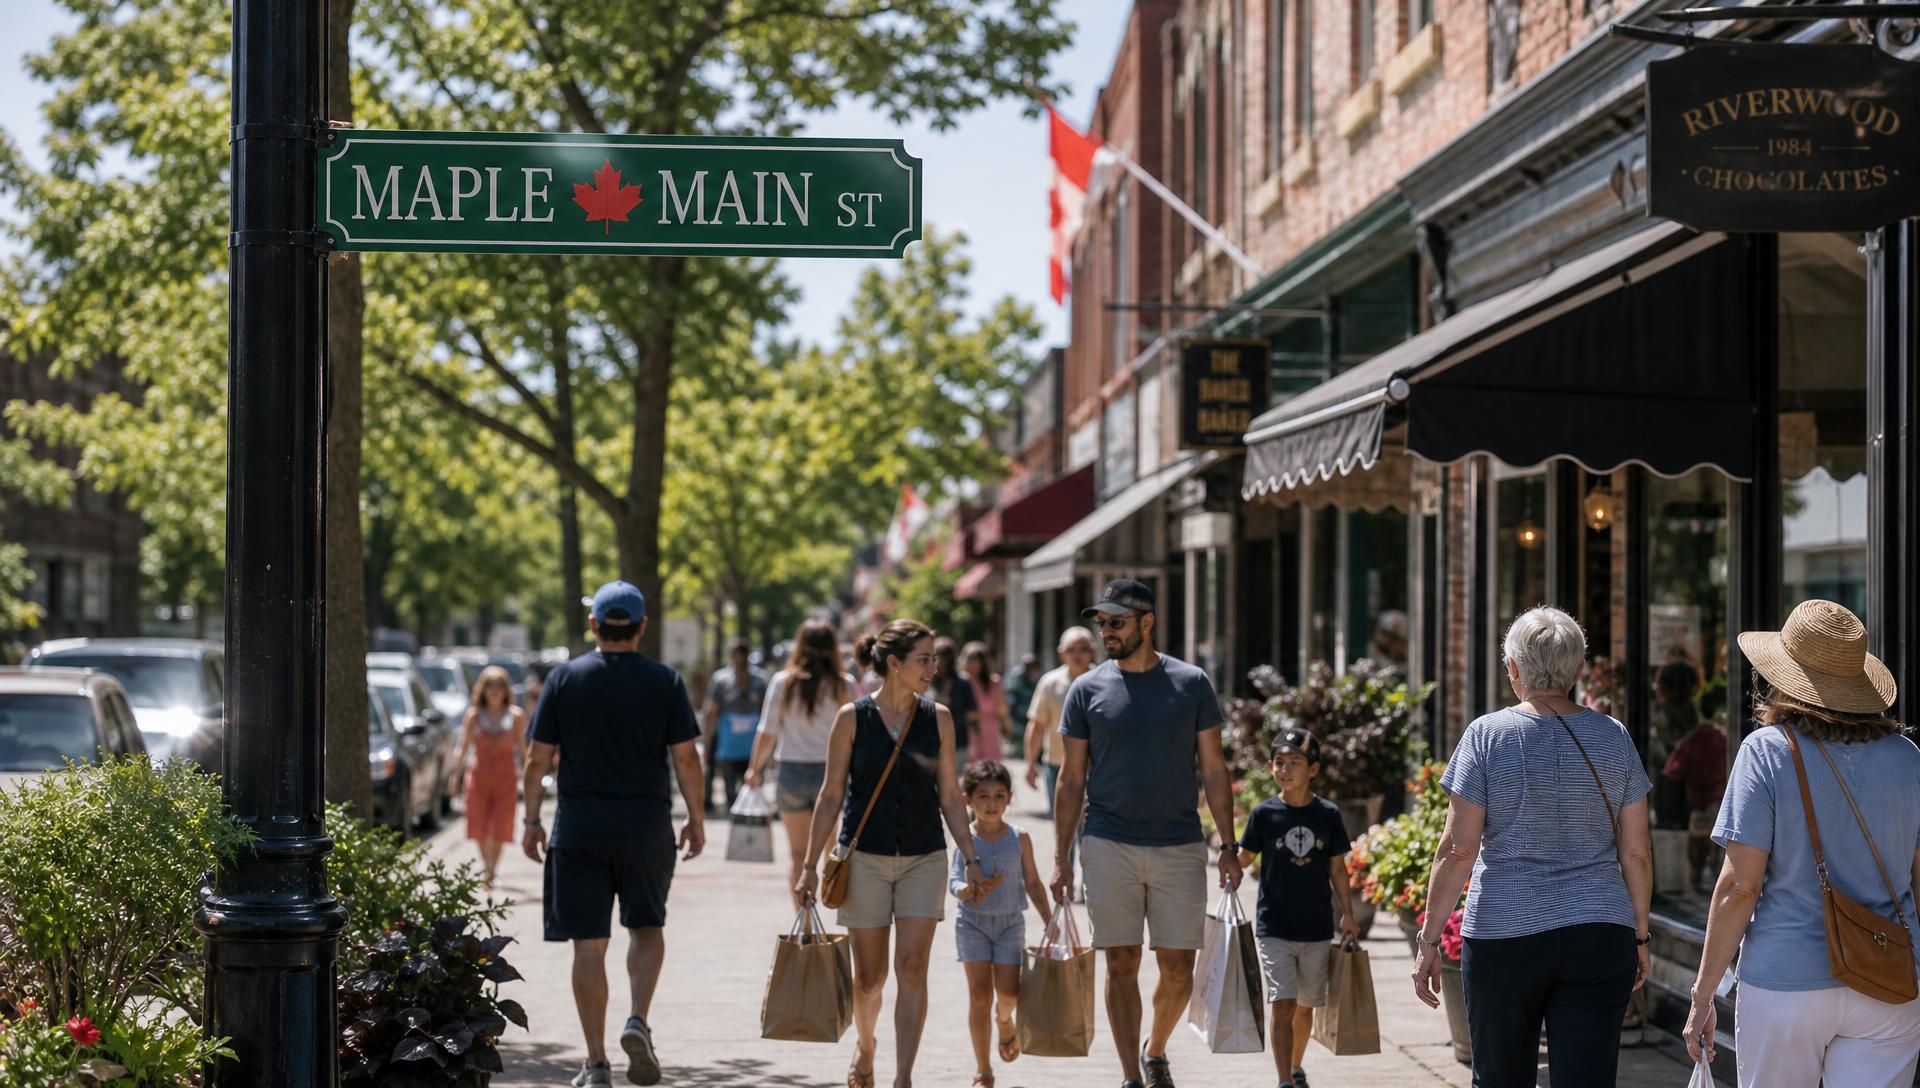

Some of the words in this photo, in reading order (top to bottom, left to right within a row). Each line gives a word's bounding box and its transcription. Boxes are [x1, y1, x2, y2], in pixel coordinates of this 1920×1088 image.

[1681, 88, 1901, 137] RIVERWOOD
[1767, 138, 1813, 156] 1984
[351, 164, 555, 223] MAPLE
[658, 169, 813, 227] MAIN
[837, 192, 883, 228] ST
[1694, 165, 1888, 192] CHOCOLATES
